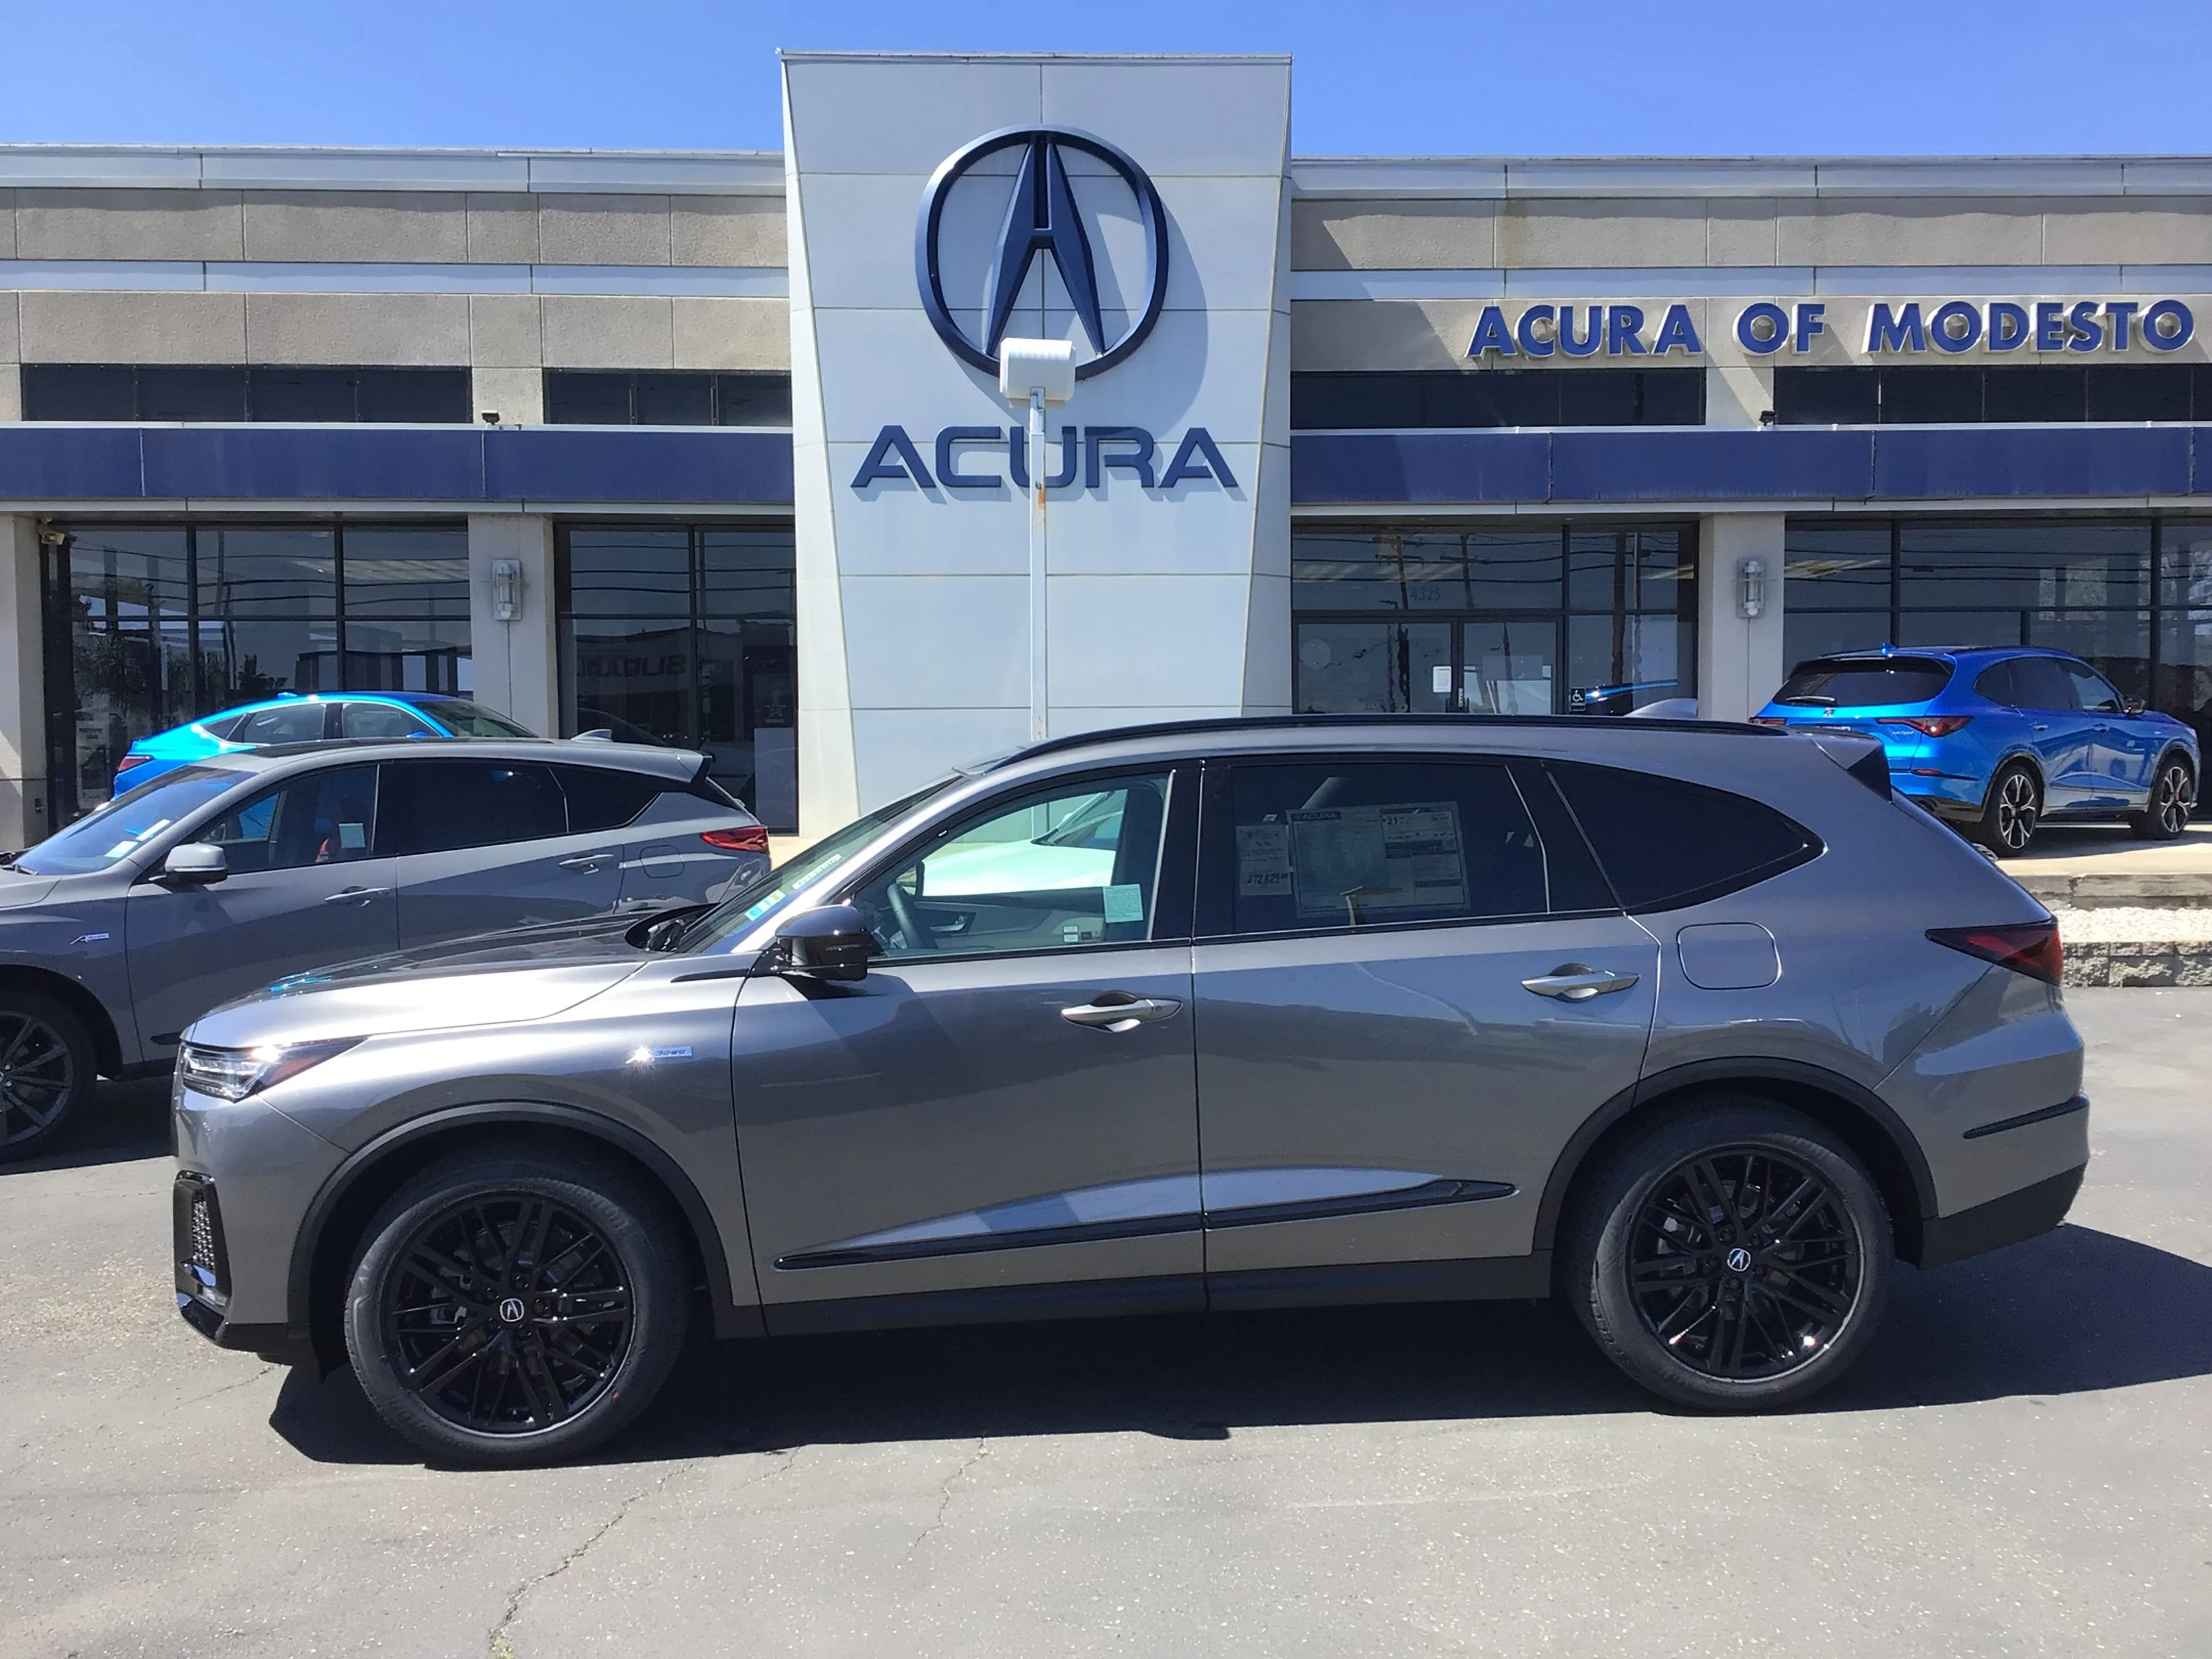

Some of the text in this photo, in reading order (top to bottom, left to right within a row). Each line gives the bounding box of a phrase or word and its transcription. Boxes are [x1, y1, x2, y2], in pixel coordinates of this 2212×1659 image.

[1465, 299, 2195, 358] ACURA OF MODESTO
[851, 424, 1239, 489] ACURA
[1410, 586, 1441, 601] 4325
